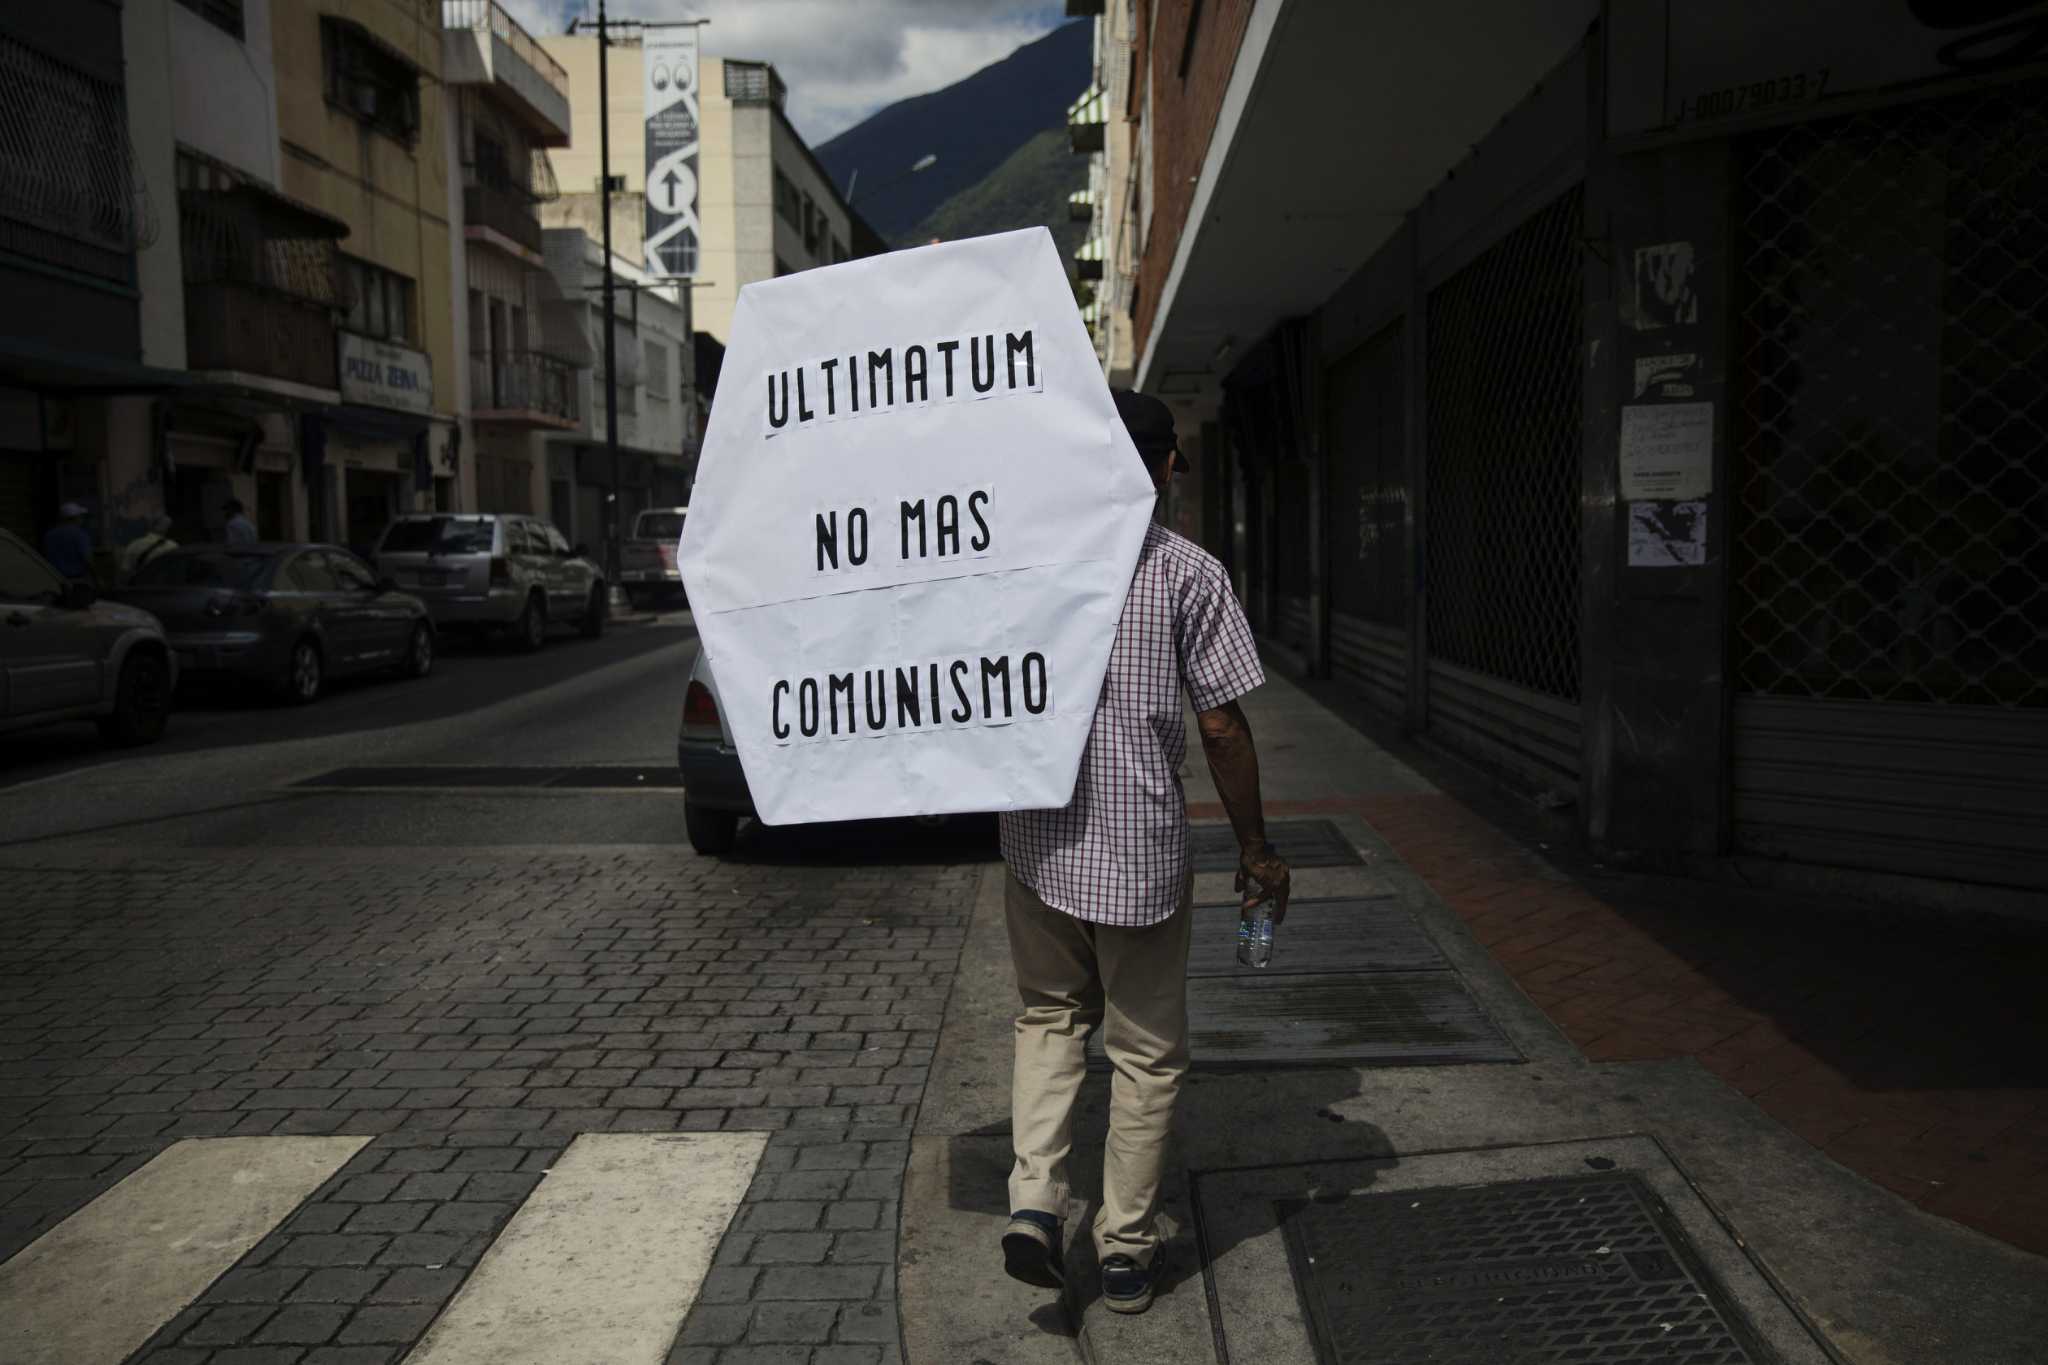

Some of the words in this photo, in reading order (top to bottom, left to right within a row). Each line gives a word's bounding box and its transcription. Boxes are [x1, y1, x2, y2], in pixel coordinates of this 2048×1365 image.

[768, 330, 1035, 429] ULTIMATUM
[816, 507, 869, 571] NO
[900, 490, 991, 559] MAS
[772, 651, 1048, 740] COMUNISMO
